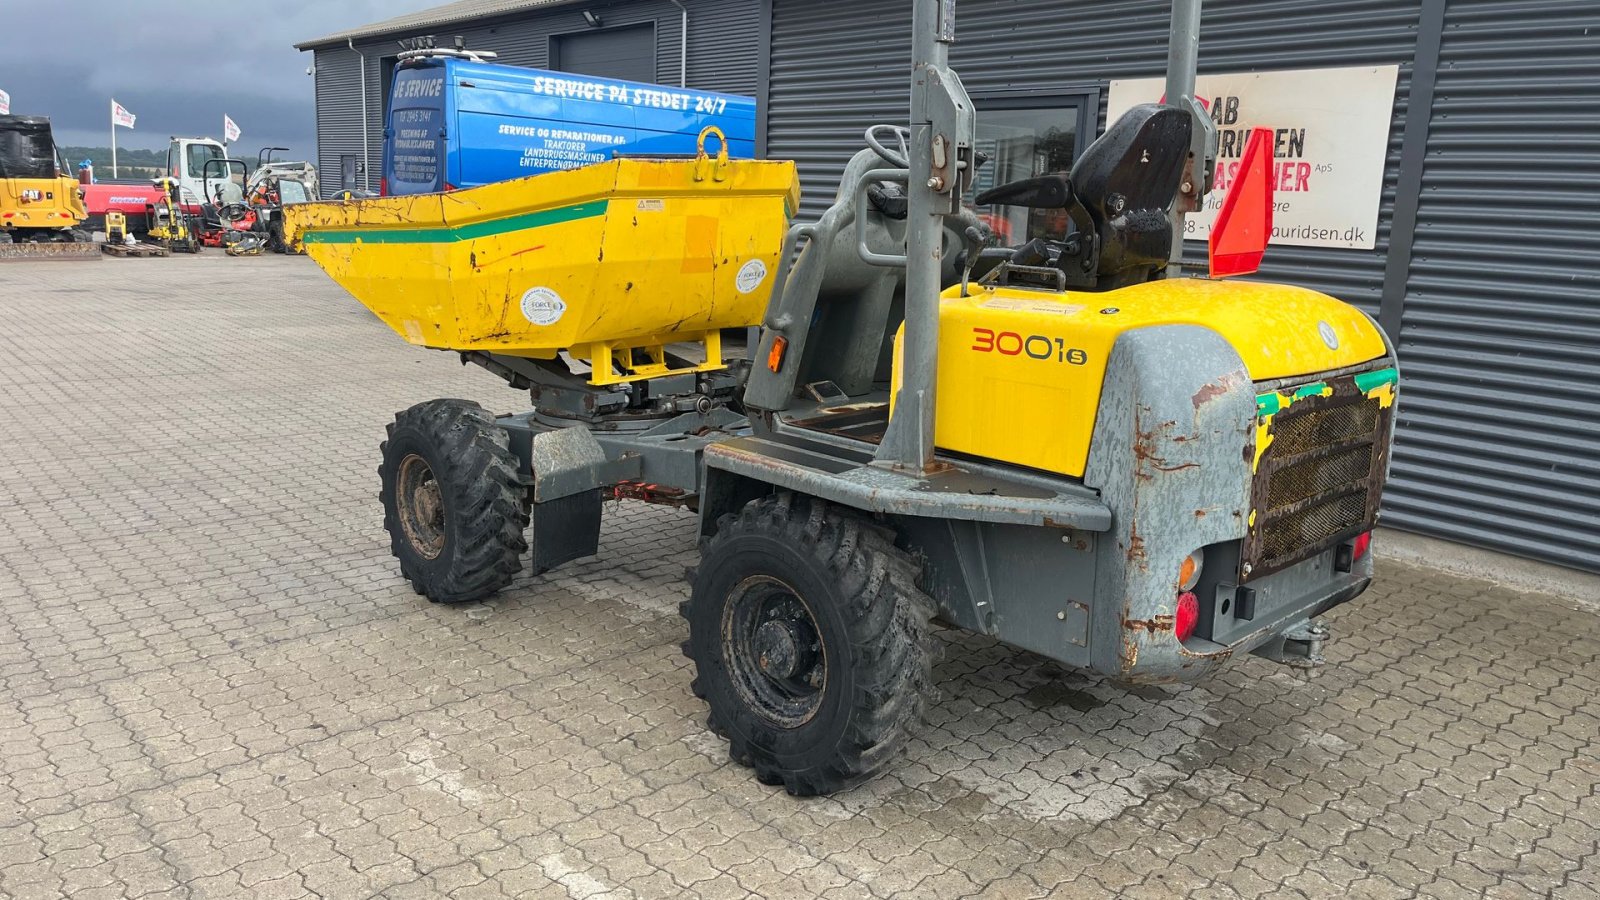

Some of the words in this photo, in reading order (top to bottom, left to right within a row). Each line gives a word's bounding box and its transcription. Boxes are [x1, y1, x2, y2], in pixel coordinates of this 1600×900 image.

[405, 78, 443, 98] SERVICE
[533, 76, 604, 100] SERVICE
[609, 84, 628, 103] PÅ
[633, 88, 690, 110] STEDET
[696, 96, 727, 115] 24/7
[1210, 96, 1239, 125] AB
[499, 124, 535, 137] SERVICE
[537, 128, 549, 137] OG
[551, 129, 612, 144] REPARATIONER
[524, 147, 606, 162] LANDBRUGSMASKINER
[544, 139, 586, 152] TRAKTORER
